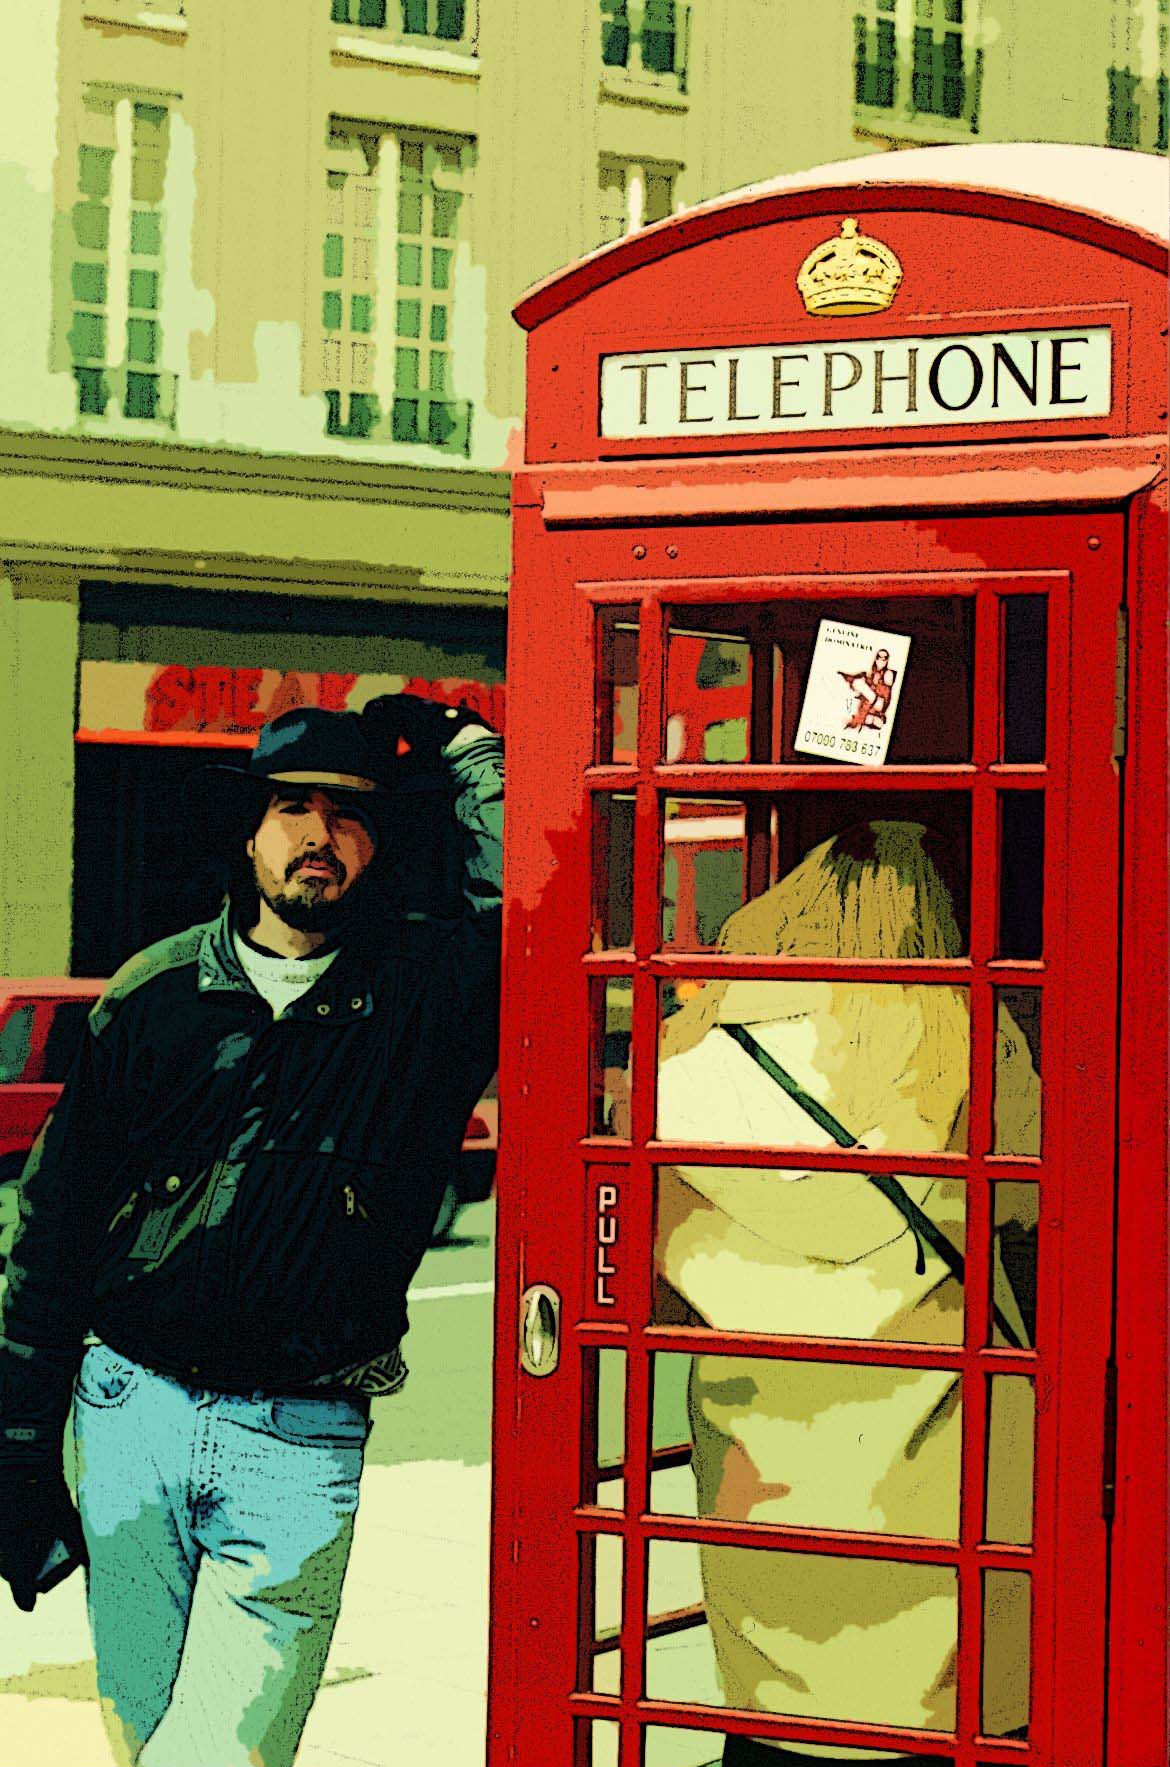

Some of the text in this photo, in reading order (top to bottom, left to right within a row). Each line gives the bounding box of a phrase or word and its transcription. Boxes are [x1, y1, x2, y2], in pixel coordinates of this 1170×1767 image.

[620, 336, 1090, 426] TELEPHONE
[804, 730, 836, 748] 07000
[861, 743, 881, 757] 637
[597, 1185, 617, 1305] PULL
